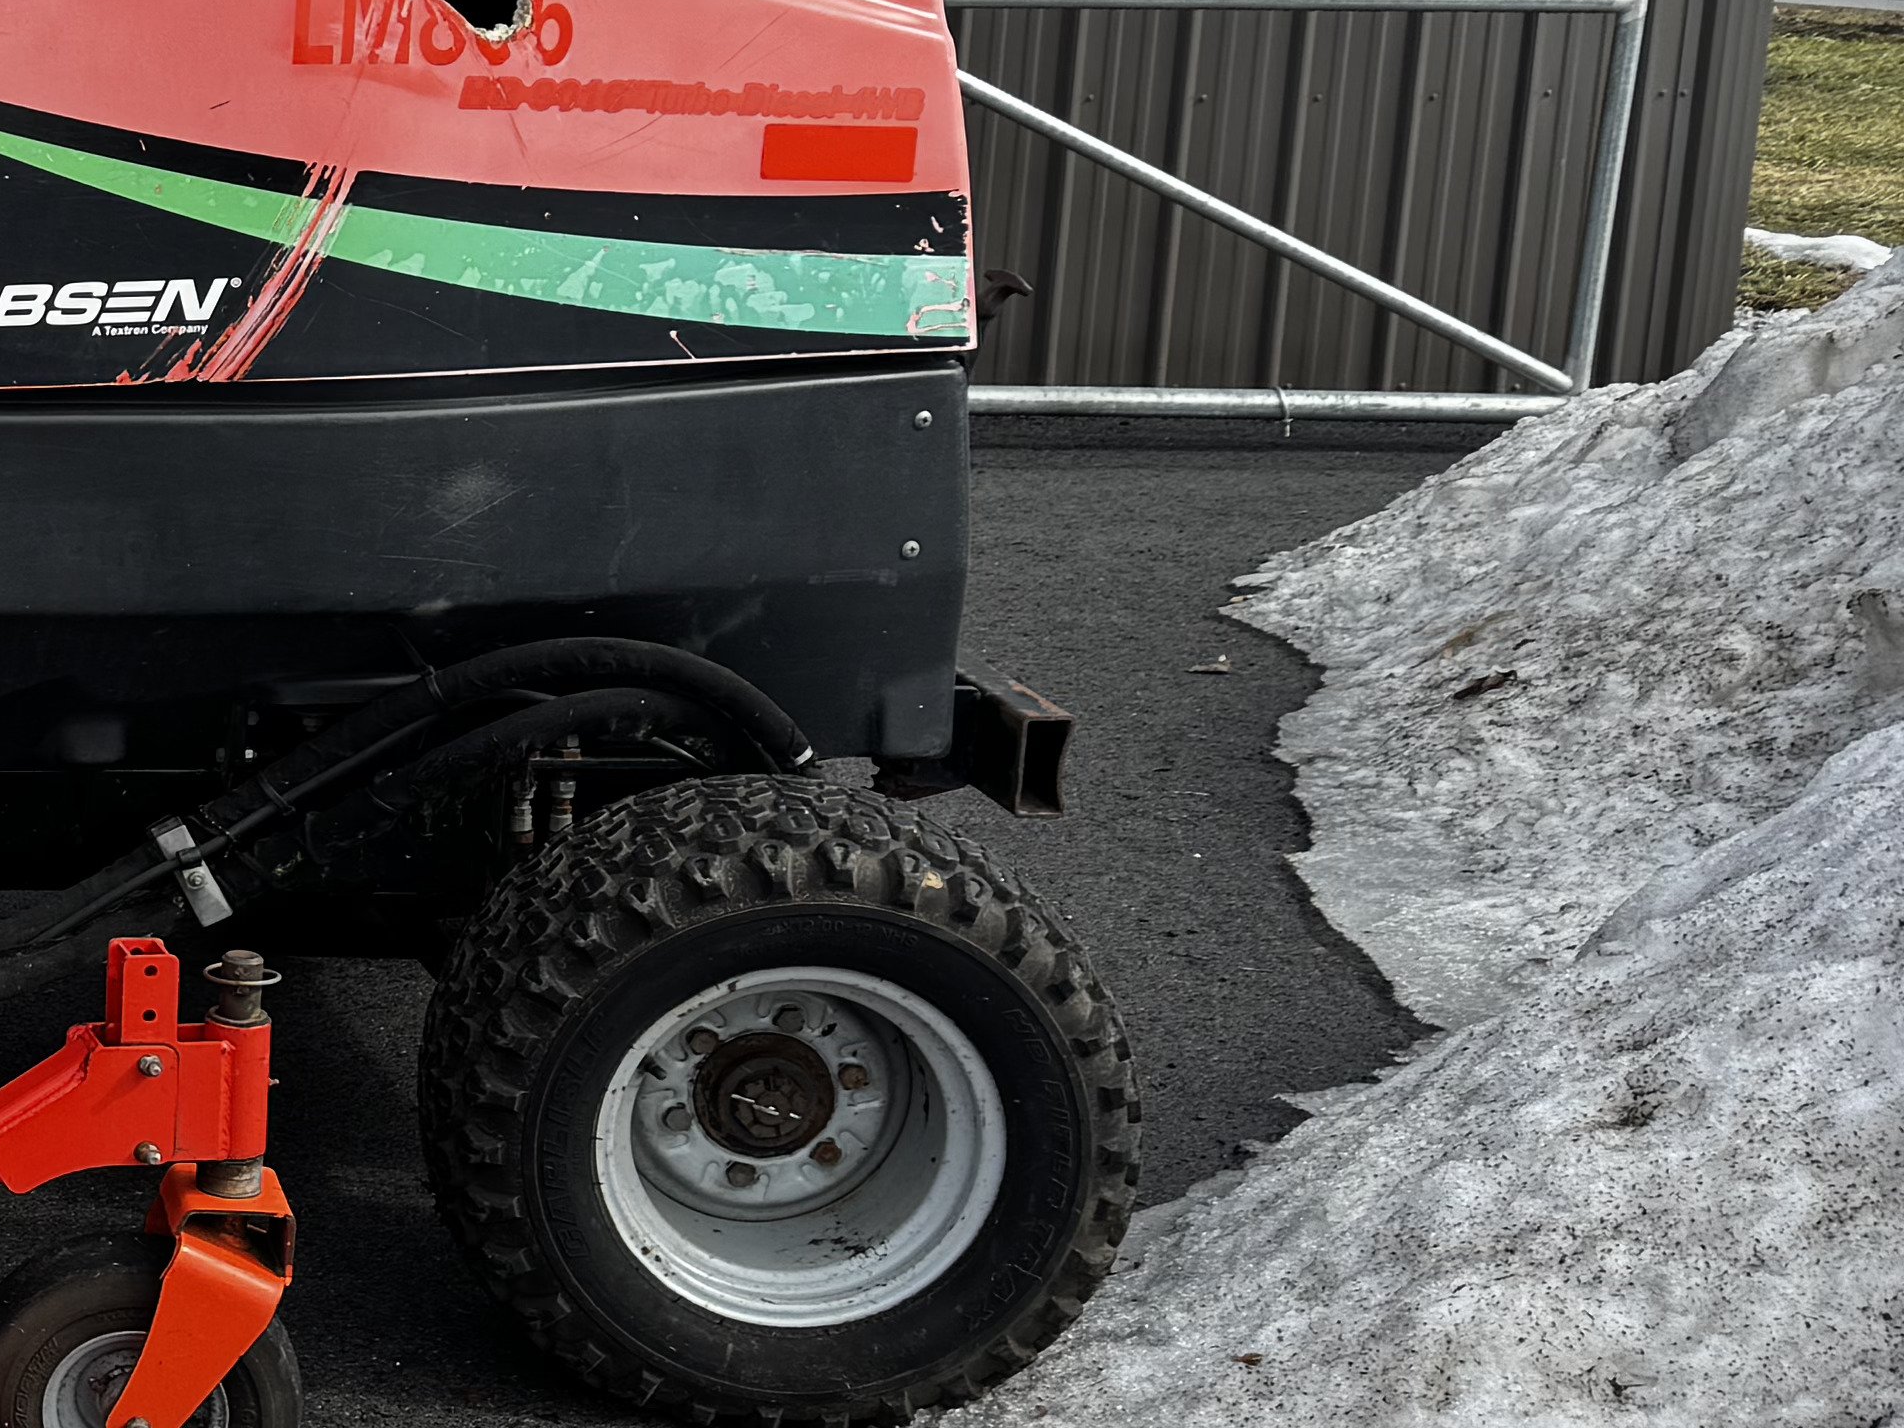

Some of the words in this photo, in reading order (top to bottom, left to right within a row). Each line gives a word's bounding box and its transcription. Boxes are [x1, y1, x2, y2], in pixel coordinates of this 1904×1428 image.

[92, 326, 102, 336] A
[104, 325, 149, 336] Textron
[151, 324, 209, 336] Company
